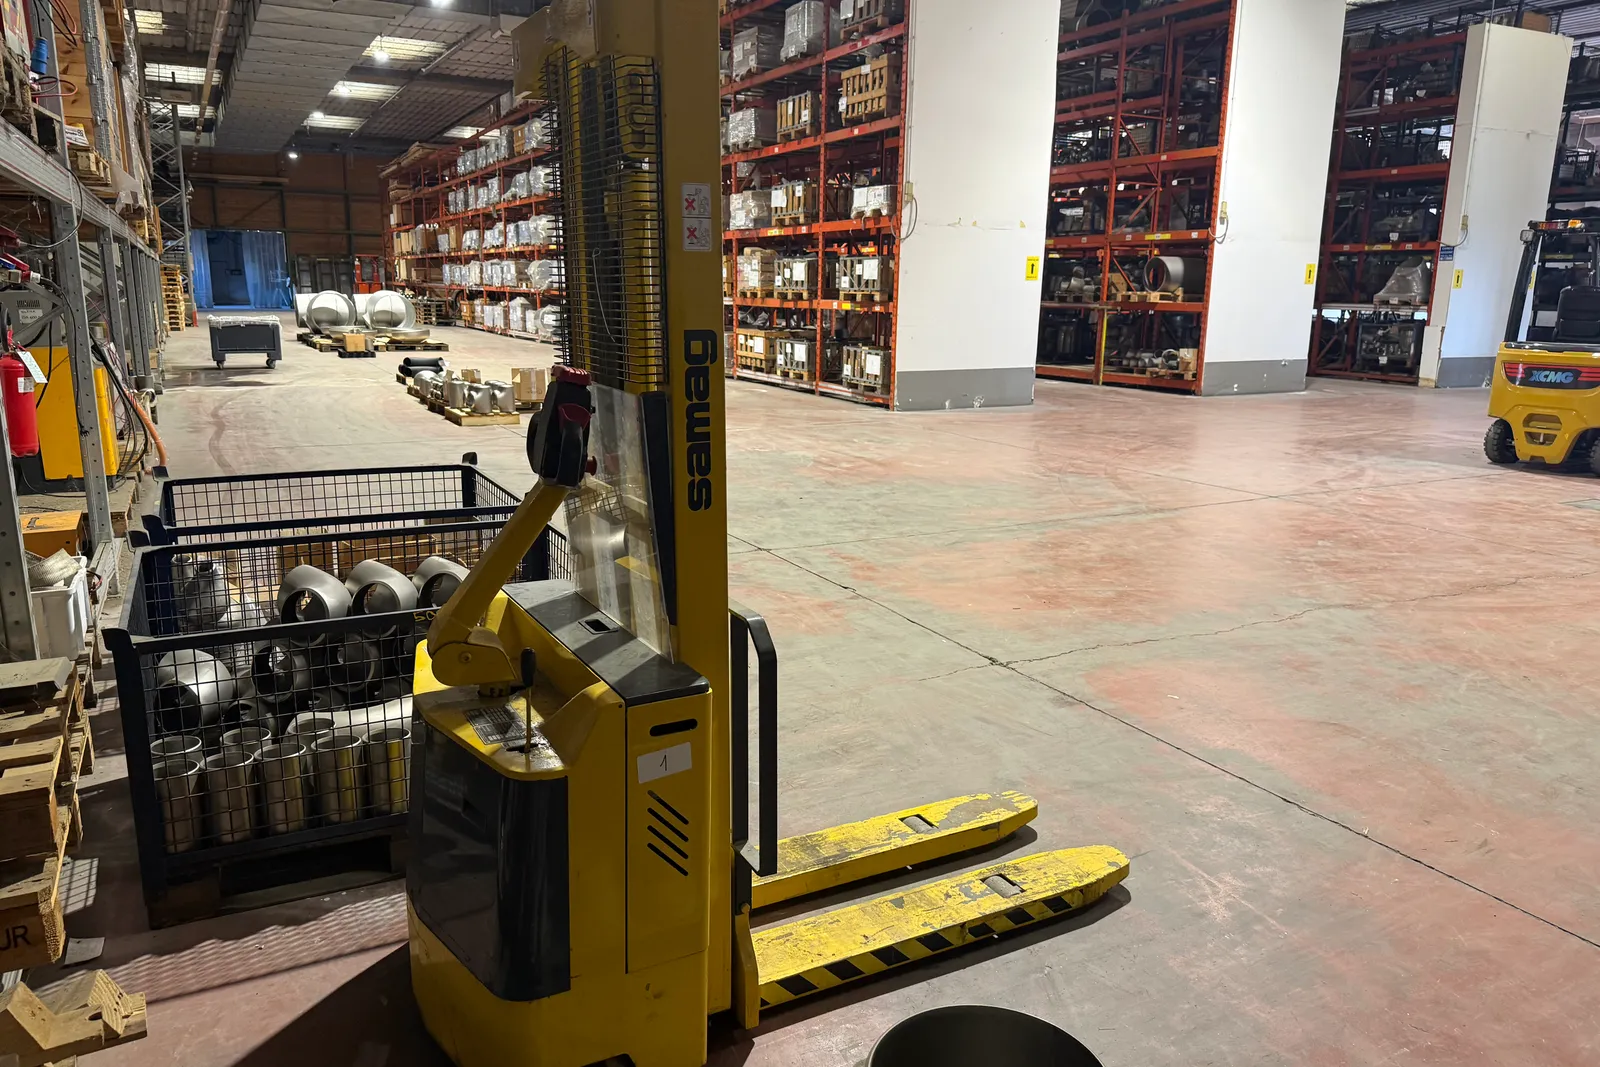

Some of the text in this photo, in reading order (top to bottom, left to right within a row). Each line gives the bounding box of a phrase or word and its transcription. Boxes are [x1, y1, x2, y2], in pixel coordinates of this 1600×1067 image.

[1529, 370, 1574, 383] XCMG
[684, 329, 718, 512] samag
[659, 754, 668, 772] 1
